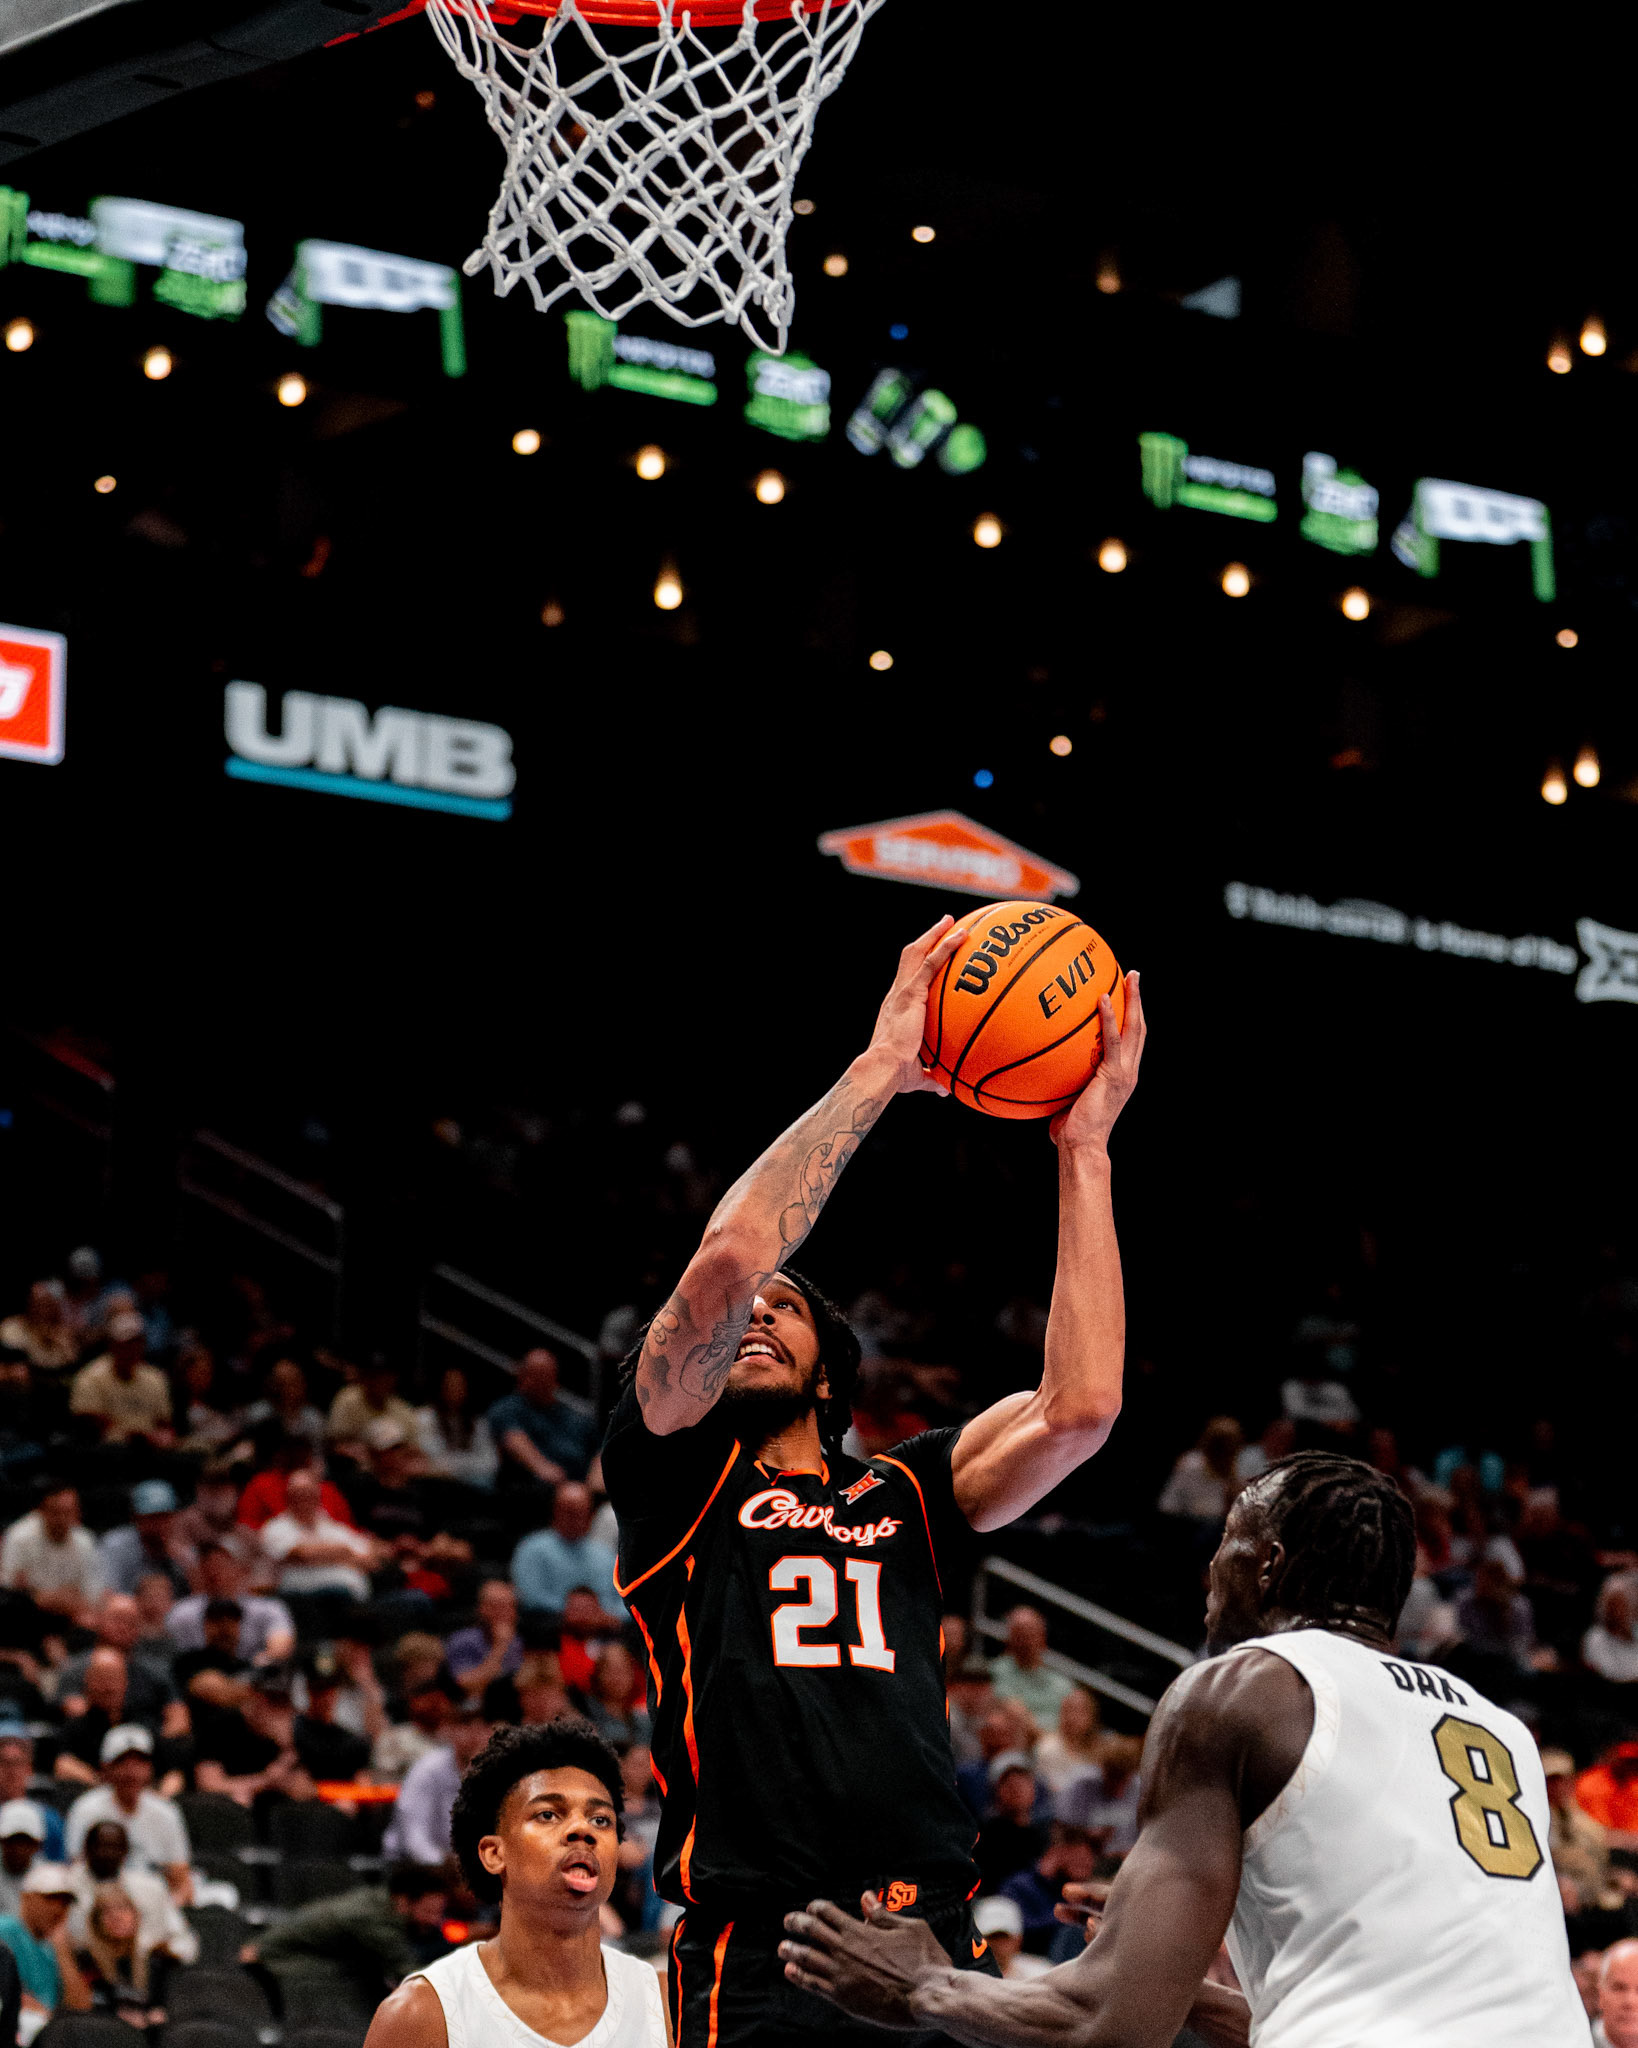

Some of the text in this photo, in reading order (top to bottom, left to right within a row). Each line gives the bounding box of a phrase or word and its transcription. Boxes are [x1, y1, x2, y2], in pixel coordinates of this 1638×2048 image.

[224, 679, 517, 798] UMB
[954, 906, 1066, 996] Wilson
[738, 1488, 903, 1547] Cowboys
[769, 1555, 896, 1674] 21
[1431, 1712, 1545, 1881] 8
